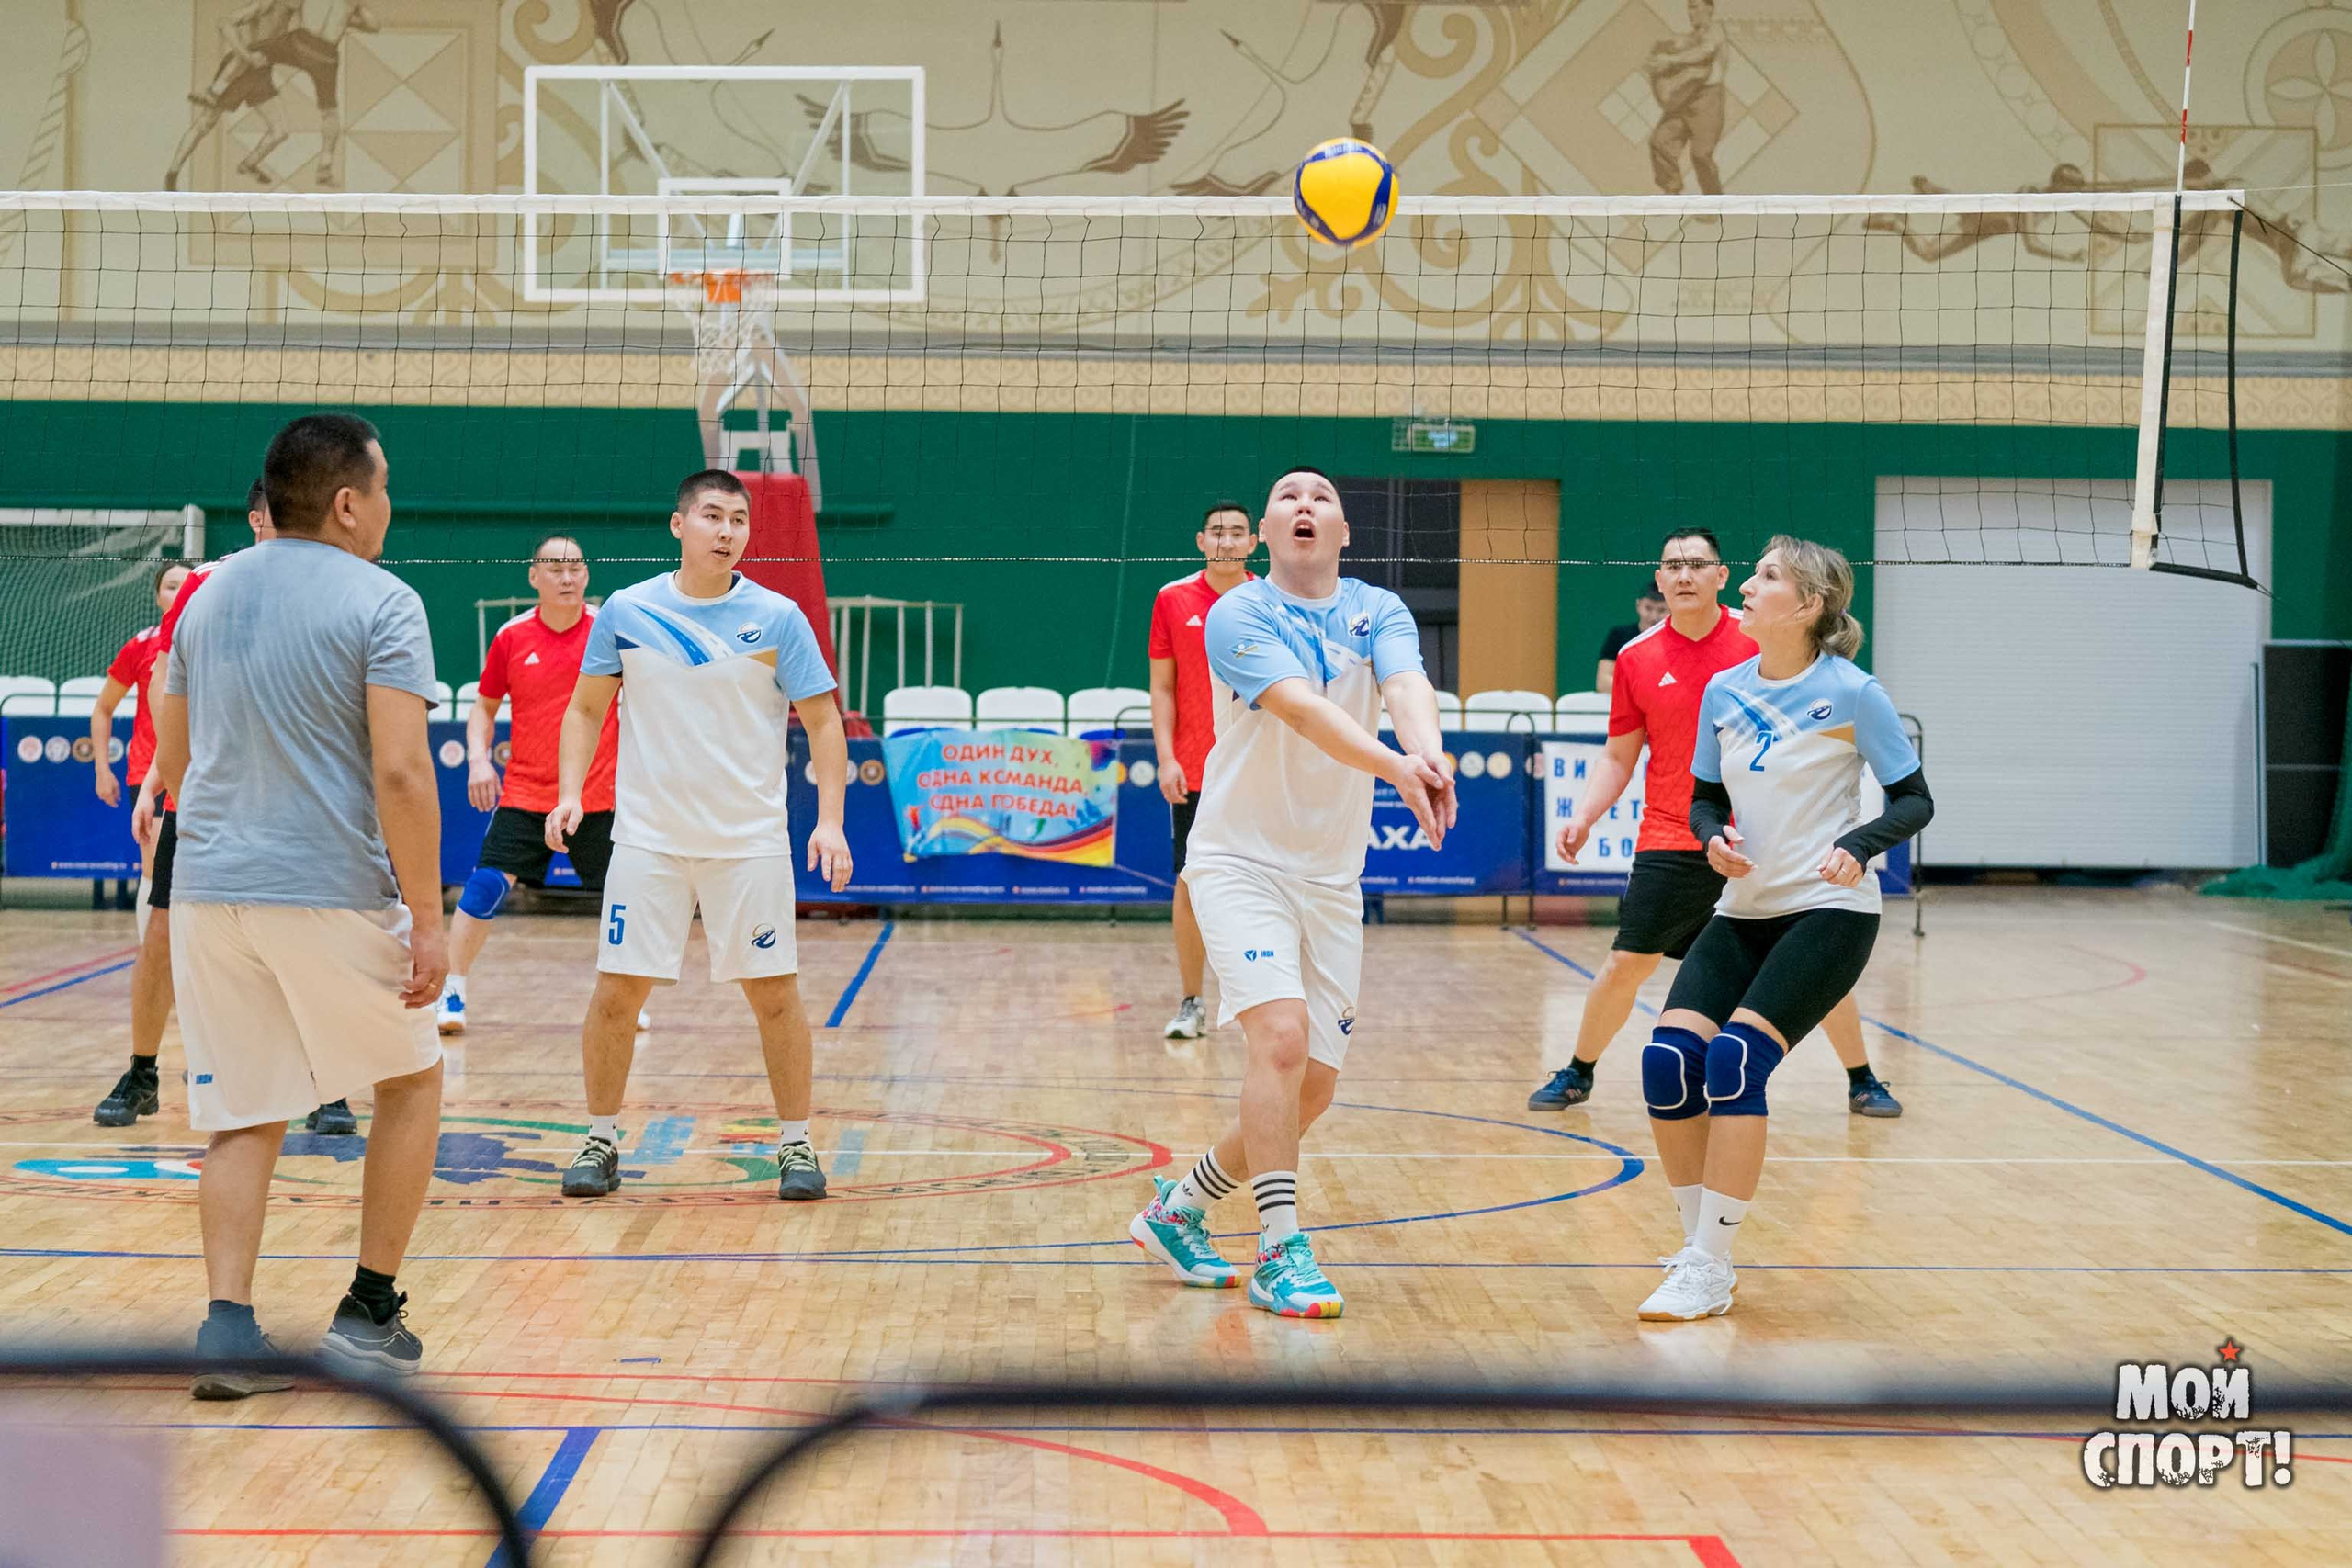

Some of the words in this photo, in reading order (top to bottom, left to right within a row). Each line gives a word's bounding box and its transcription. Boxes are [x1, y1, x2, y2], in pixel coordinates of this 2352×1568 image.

[942, 744, 1005, 761] ОДИН
[1009, 745, 1058, 768] ДУХ,
[1748, 730, 1773, 772] 2
[991, 794, 1077, 818] ПОБЕДА!
[608, 903, 627, 946] 5
